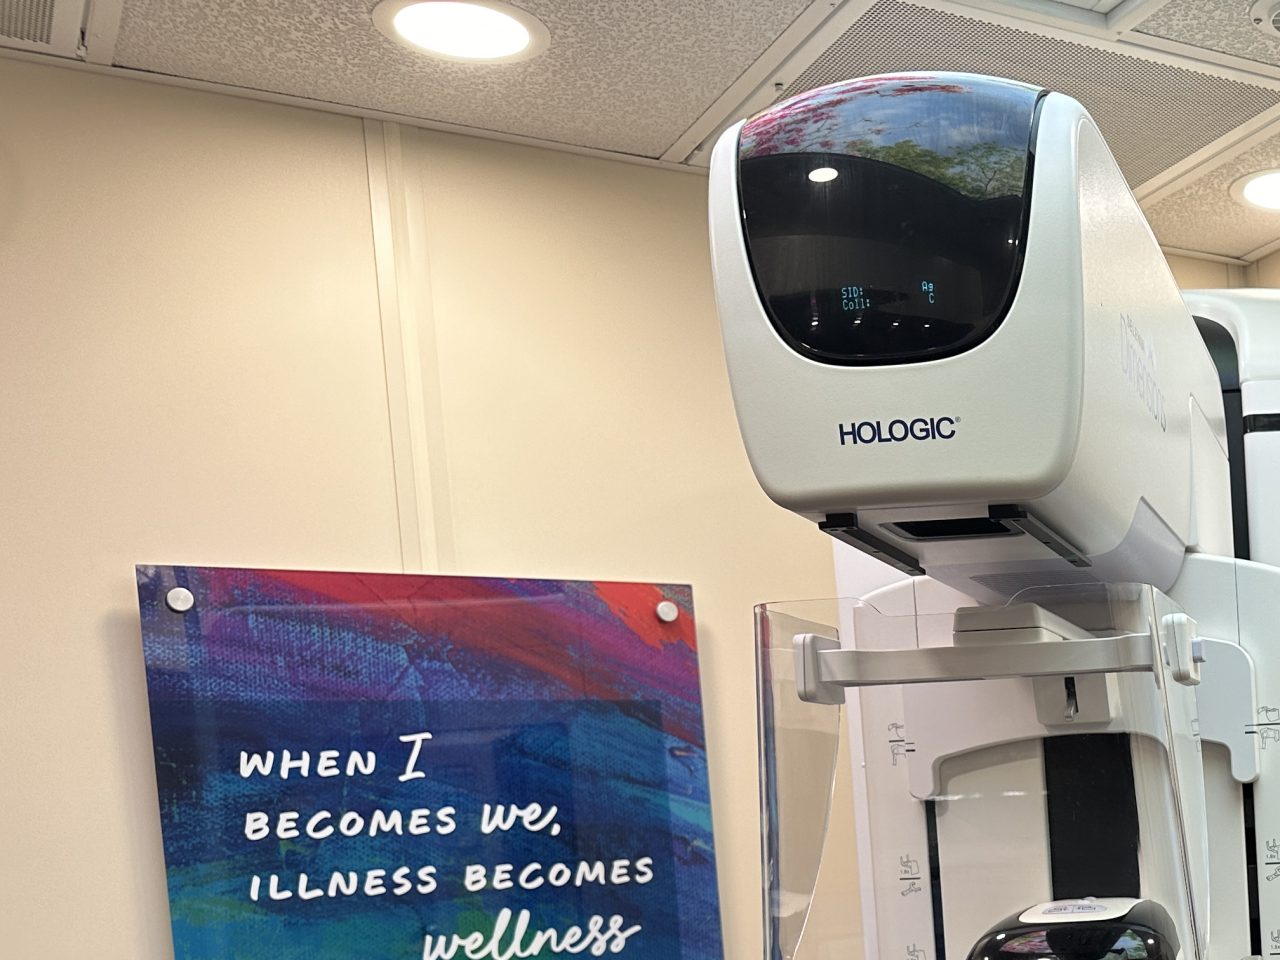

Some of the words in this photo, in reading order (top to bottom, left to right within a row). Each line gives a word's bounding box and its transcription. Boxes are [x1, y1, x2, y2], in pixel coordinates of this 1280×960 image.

[841, 286, 864, 299] SID:
[921, 280, 934, 293] Ag
[842, 298, 871, 311] Coll:
[928, 293, 935, 304] C
[838, 416, 956, 446] HOLOGIC
[239, 749, 378, 781] WHEN
[398, 731, 433, 783] I
[243, 805, 458, 842] BECOMES
[480, 801, 563, 837] we,
[249, 864, 438, 902] ILLNESS
[463, 856, 655, 893] BECOMES
